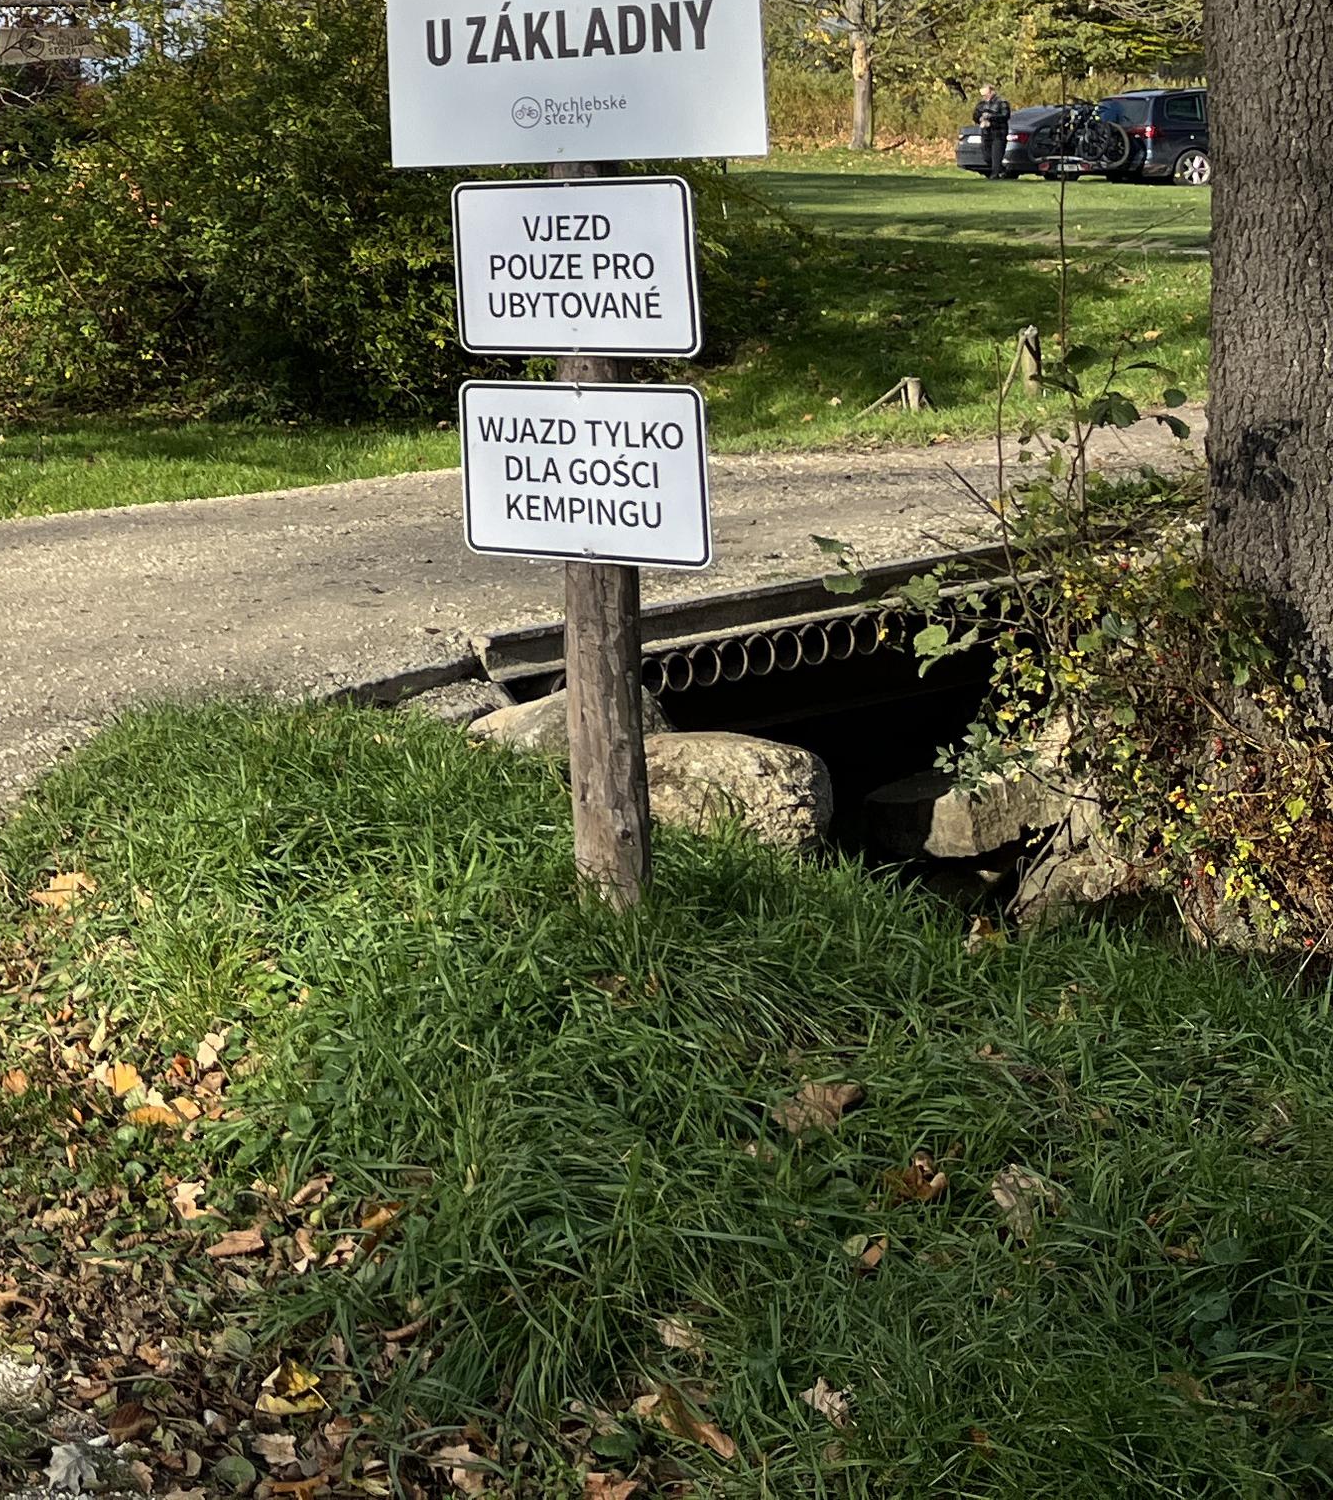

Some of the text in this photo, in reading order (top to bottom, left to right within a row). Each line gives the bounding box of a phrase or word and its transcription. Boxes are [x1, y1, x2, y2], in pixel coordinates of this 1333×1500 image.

[426, 18, 452, 67] U
[544, 94, 627, 116] Rychlebské
[544, 113, 593, 129] stezky
[522, 214, 611, 242] VJEZD
[489, 252, 655, 281] POUZE PRO
[488, 285, 662, 319] UBYTOVANÉ
[478, 416, 684, 450] WJAZD TYLKO
[504, 453, 659, 489] DLA GOŚCI
[506, 493, 662, 529] KEMPINGU
